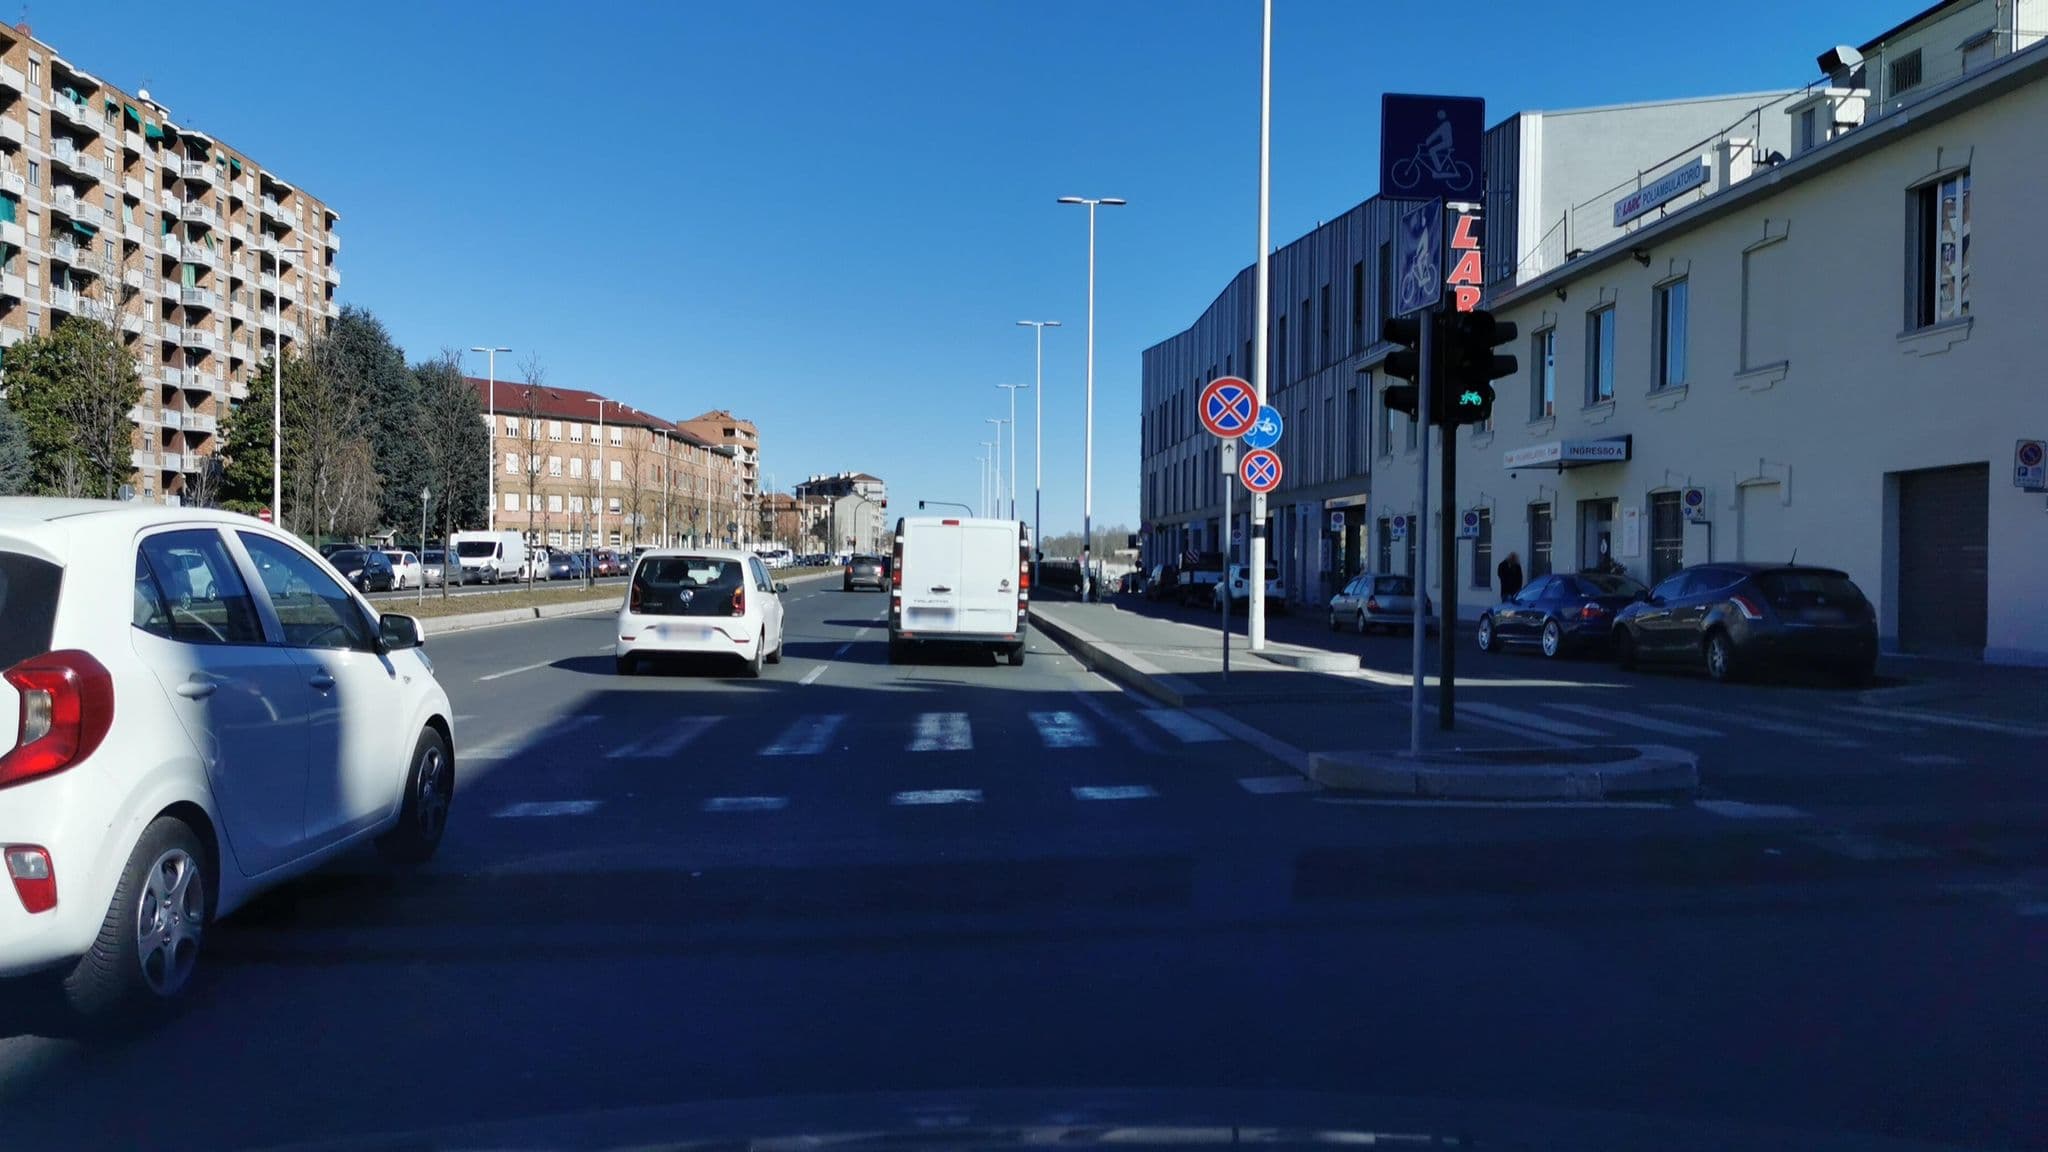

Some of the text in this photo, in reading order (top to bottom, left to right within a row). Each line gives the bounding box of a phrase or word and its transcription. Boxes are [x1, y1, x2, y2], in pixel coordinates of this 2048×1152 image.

[1622, 165, 1701, 217] LARC POLIAMBULATORIO
[1569, 446, 1615, 456] INGRESSO
[1616, 447, 1623, 456] A
